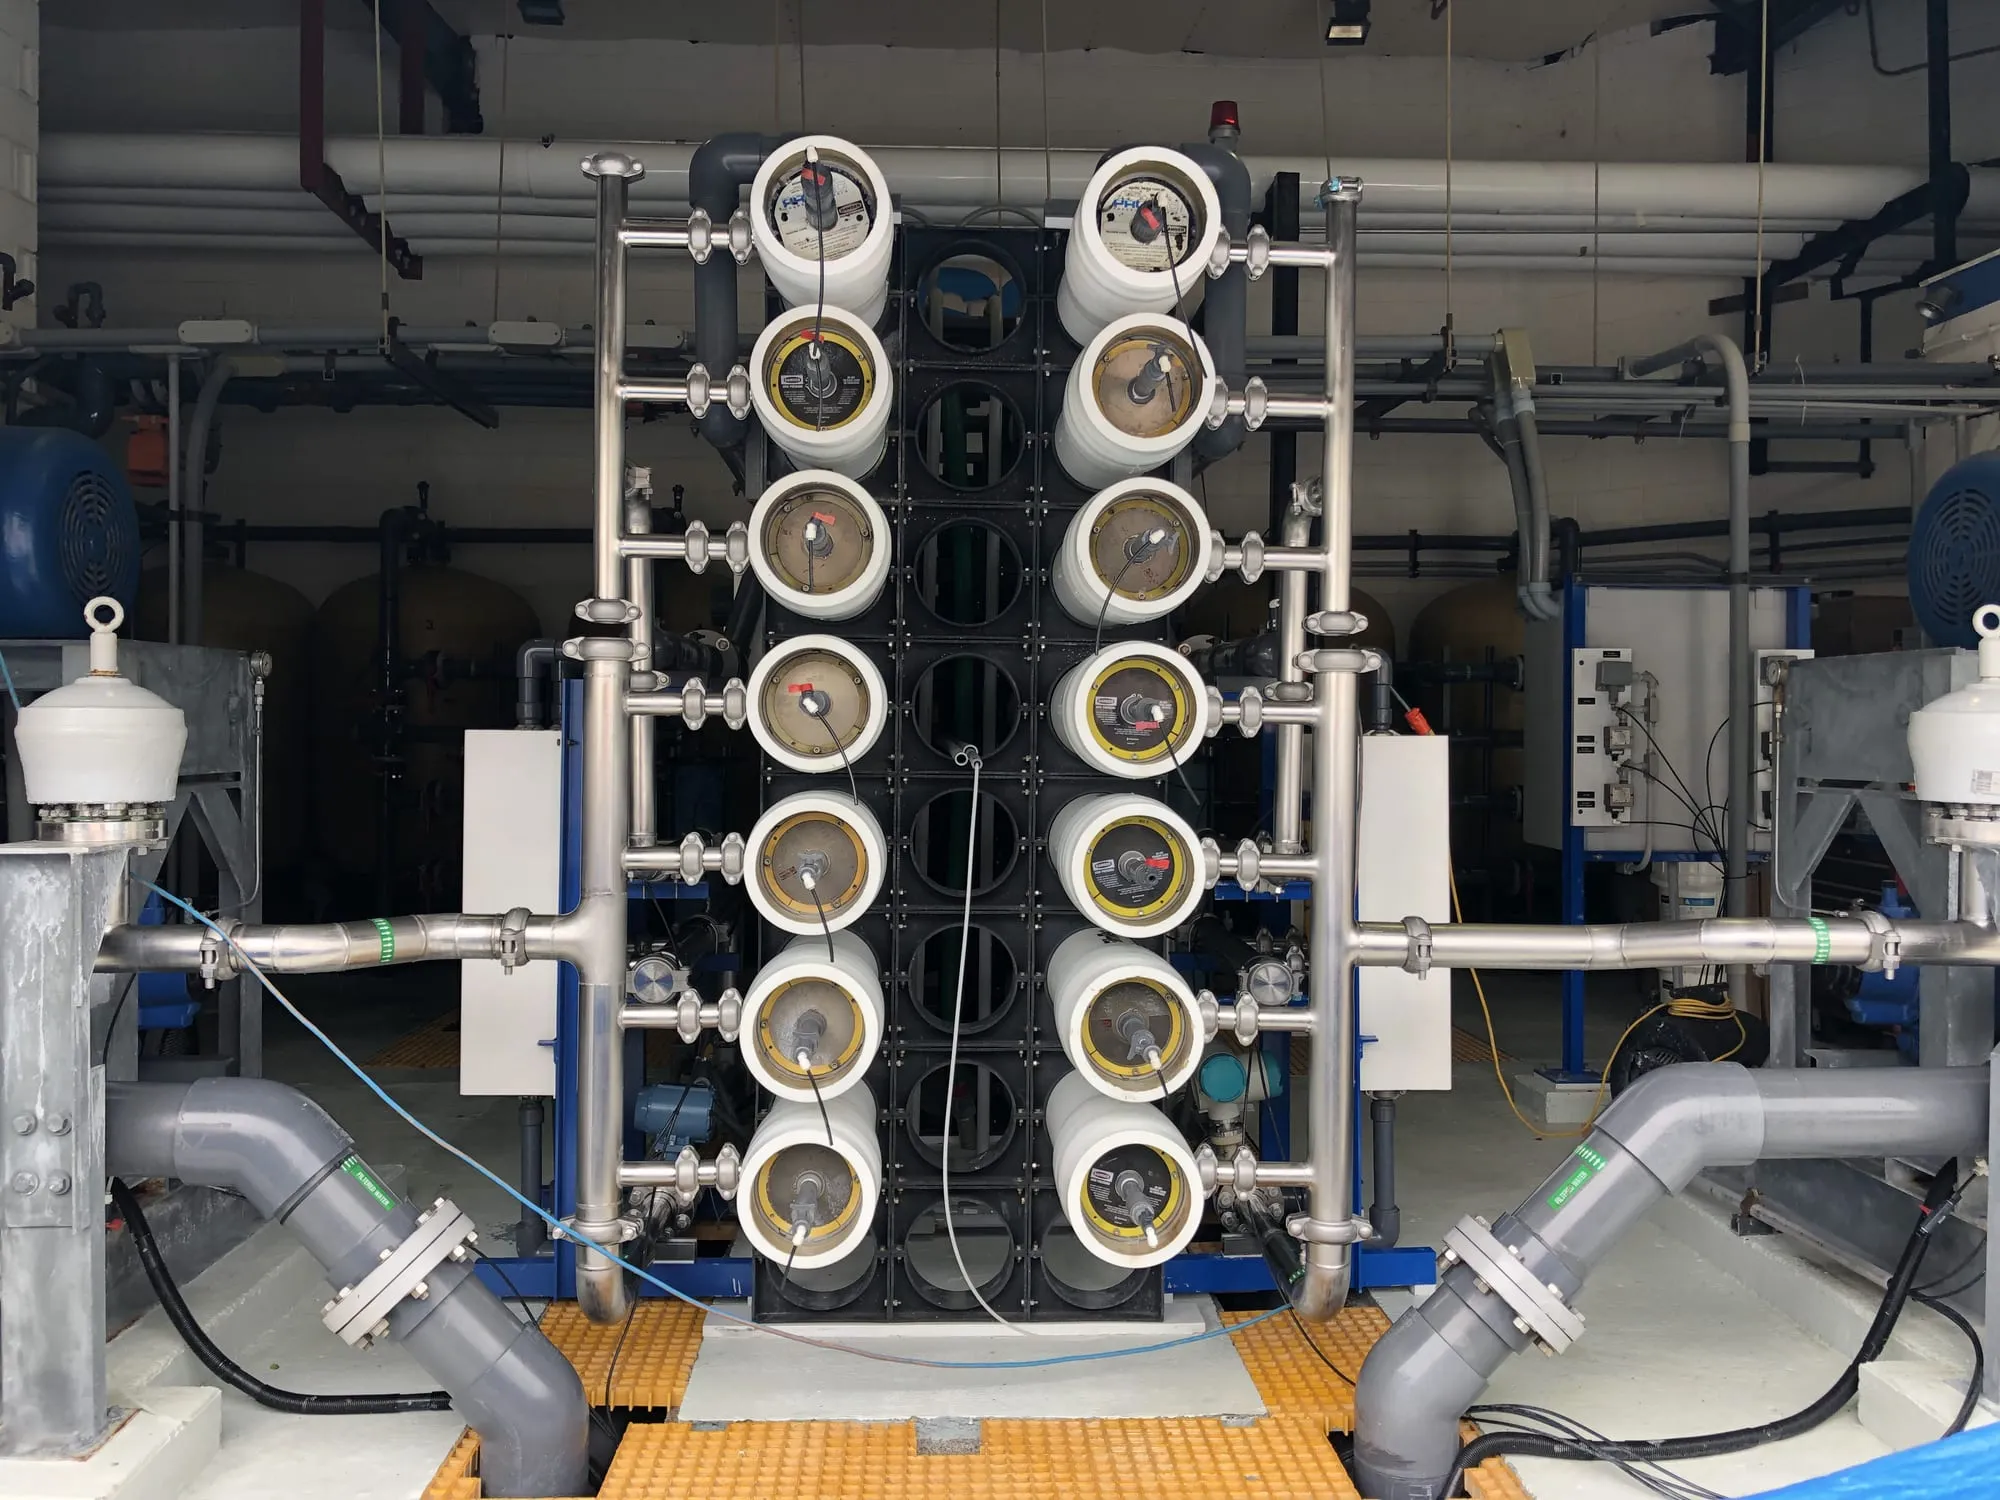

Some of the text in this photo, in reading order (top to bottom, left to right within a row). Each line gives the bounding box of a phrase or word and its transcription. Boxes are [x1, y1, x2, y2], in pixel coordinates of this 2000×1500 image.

[357, 1171, 390, 1206] FILTERED WATER
[1571, 1171, 1587, 1187] WATER
